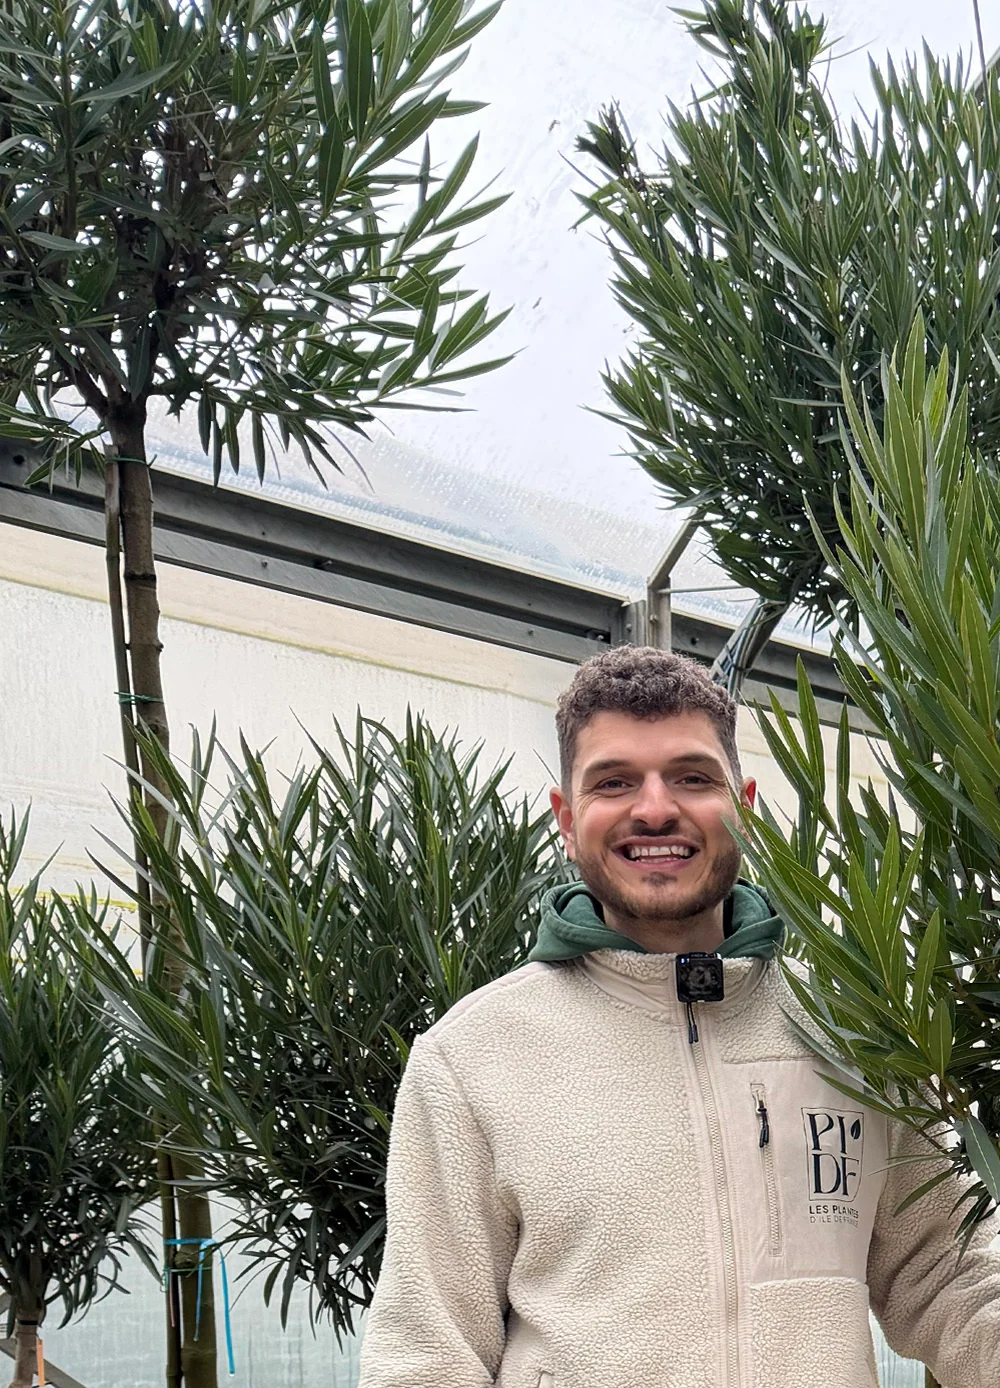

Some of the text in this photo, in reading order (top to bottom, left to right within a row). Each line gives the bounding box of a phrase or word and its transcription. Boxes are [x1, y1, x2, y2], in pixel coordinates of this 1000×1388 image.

[807, 1113, 847, 1154] PI
[812, 1153, 860, 1196] DF
[809, 1205, 859, 1219] LES PLANTES
